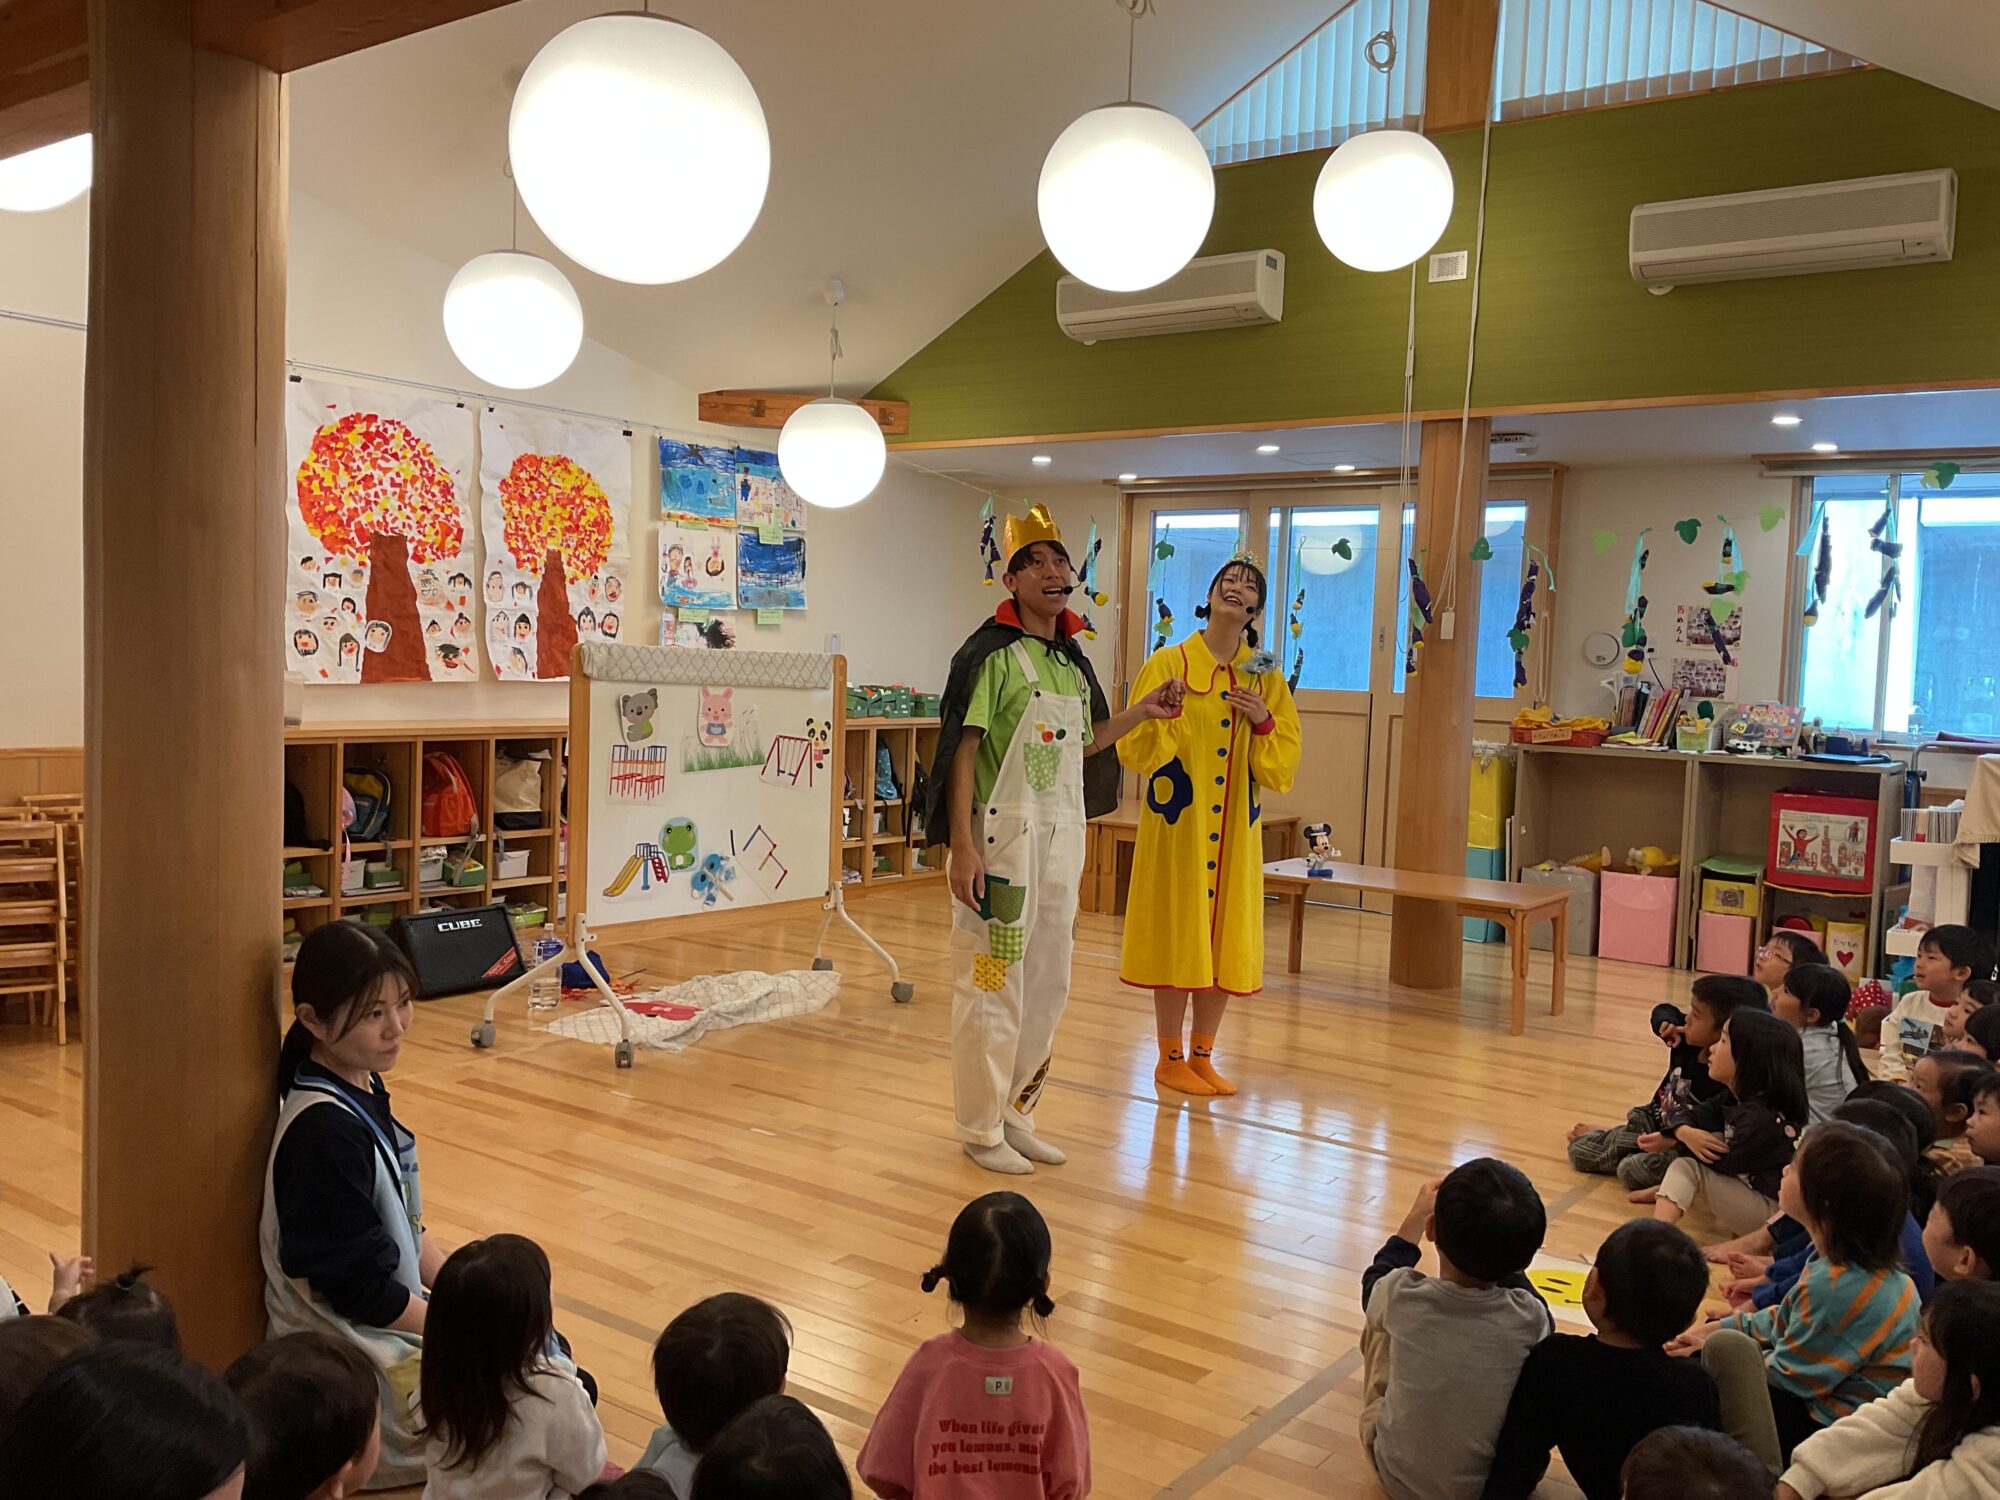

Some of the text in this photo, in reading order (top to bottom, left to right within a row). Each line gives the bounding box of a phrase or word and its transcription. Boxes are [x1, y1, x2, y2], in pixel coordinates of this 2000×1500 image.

[437, 918, 482, 932] CUBE
[939, 1419, 978, 1434] When
[981, 1420, 1005, 1434] life
[932, 1442, 957, 1458] you
[928, 1462, 947, 1476] the
[953, 1460, 983, 1474] best
